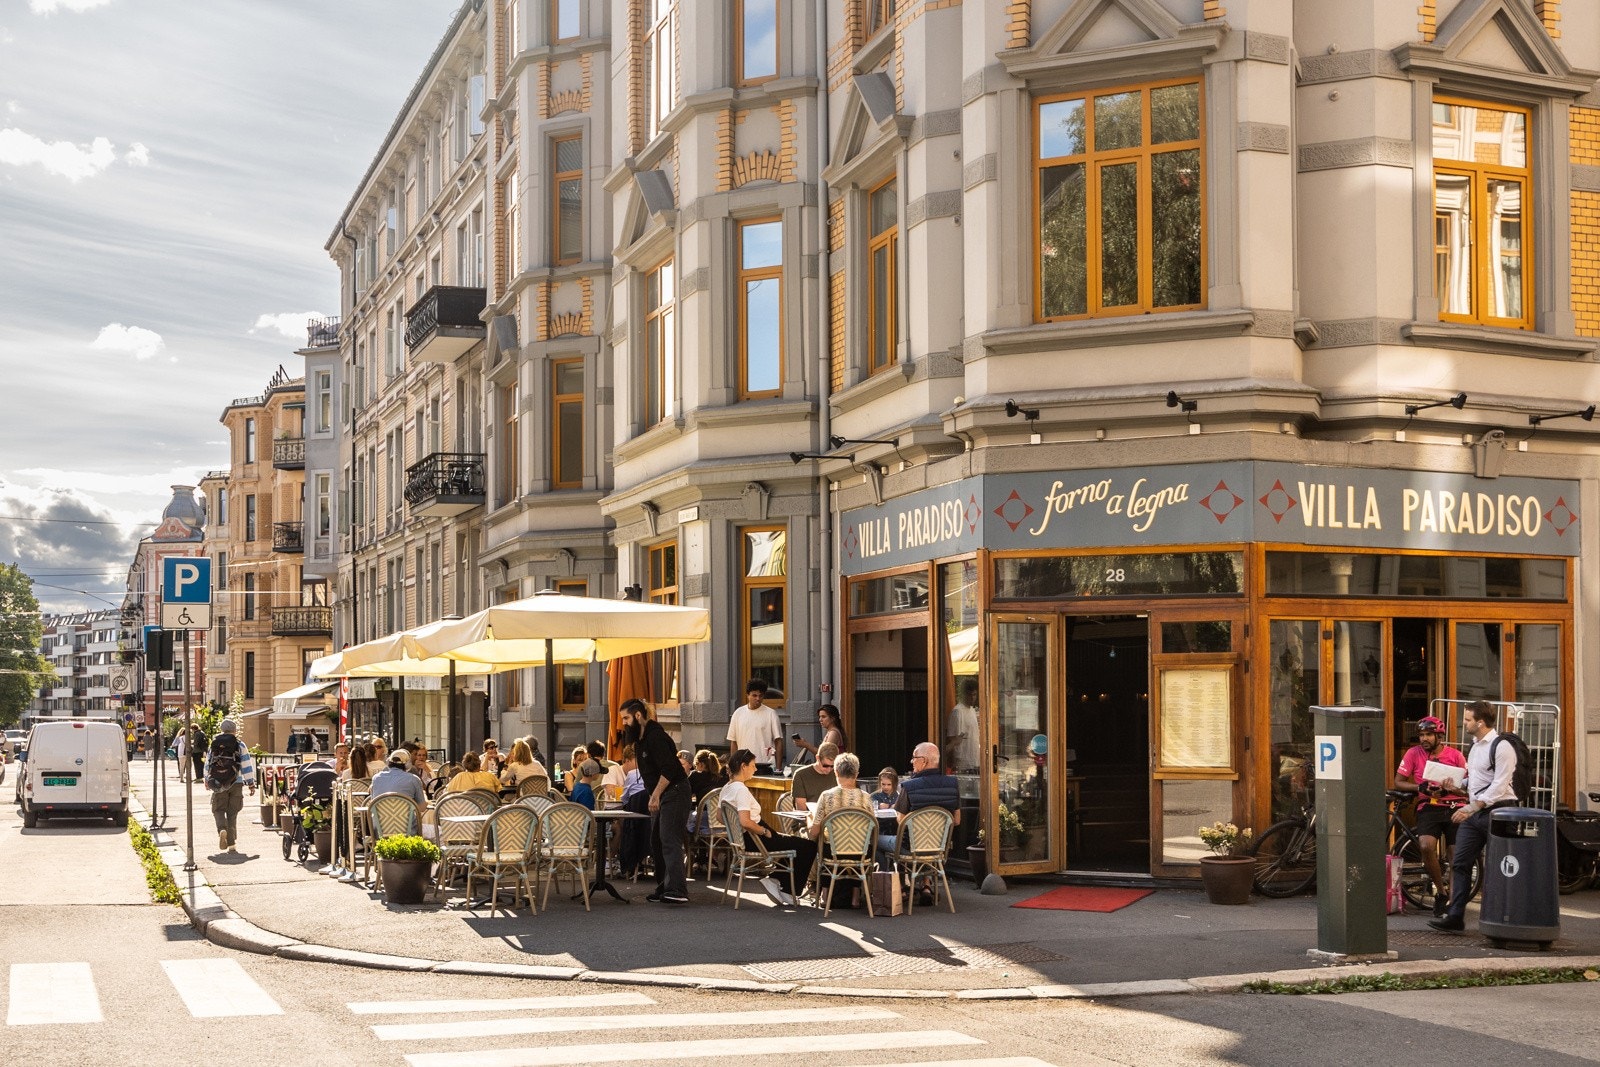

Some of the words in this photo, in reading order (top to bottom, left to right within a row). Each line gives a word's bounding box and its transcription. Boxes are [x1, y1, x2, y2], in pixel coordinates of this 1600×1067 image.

[858, 517, 890, 558] VILLA
[898, 498, 963, 550] PARADISO
[1029, 479, 1112, 536] forno
[1106, 494, 1122, 515] a
[1126, 478, 1188, 532] legna
[1298, 481, 1382, 530] VILLA
[1403, 488, 1542, 537] PARADISO
[175, 564, 199, 597] P
[1105, 568, 1126, 583] 28
[1320, 743, 1336, 771] P
